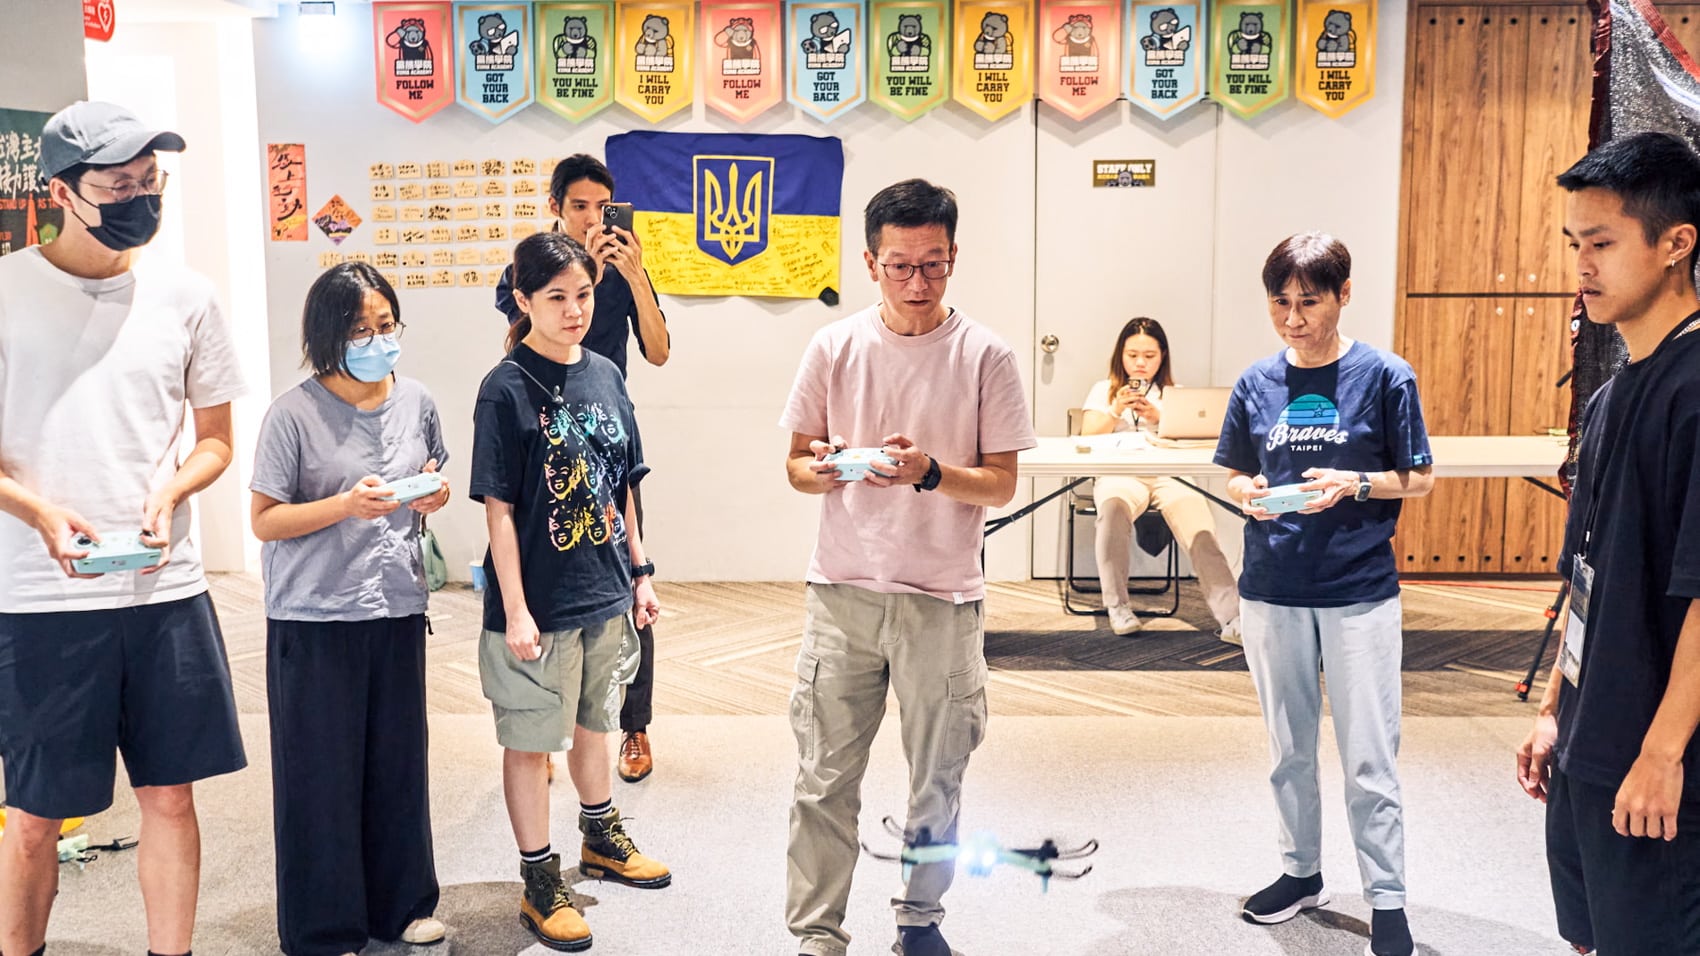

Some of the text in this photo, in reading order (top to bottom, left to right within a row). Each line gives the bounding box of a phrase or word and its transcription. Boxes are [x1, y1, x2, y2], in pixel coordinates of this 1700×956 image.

[486, 73, 504, 84] GOT
[817, 72, 835, 81] GOT
[978, 72, 1008, 82] I WILL
[1155, 69, 1174, 78] GOT
[1320, 71, 1350, 80] I WILL
[552, 78, 598, 88] YOU WILL
[640, 75, 669, 84] I WILL
[722, 79, 761, 88] FOLLOW
[886, 76, 932, 86] YOU WILL
[1060, 76, 1099, 86] FOLLOW
[1151, 79, 1178, 89] YOUR
[1226, 74, 1272, 84] YOU WILL
[396, 80, 434, 90] FOLLOW
[482, 84, 508, 93] YOUR
[638, 85, 671, 95] CARRY
[813, 82, 840, 92] YOUR
[976, 83, 1010, 93] CARRY
[1229, 84, 1268, 94] BE FINE
[1318, 81, 1352, 91] CARRY
[408, 90, 423, 100] ME
[556, 88, 594, 98] BE FINE
[735, 90, 750, 99] ME
[890, 86, 928, 96] BE FINE
[1072, 87, 1087, 96] ME
[1151, 89, 1178, 99] BACK
[1325, 91, 1344, 101] YOU
[482, 94, 508, 103] BACK
[645, 95, 664, 105] YOU
[813, 92, 840, 102] BACK
[983, 93, 1003, 103] YOU
[1266, 421, 1349, 451] Braves
